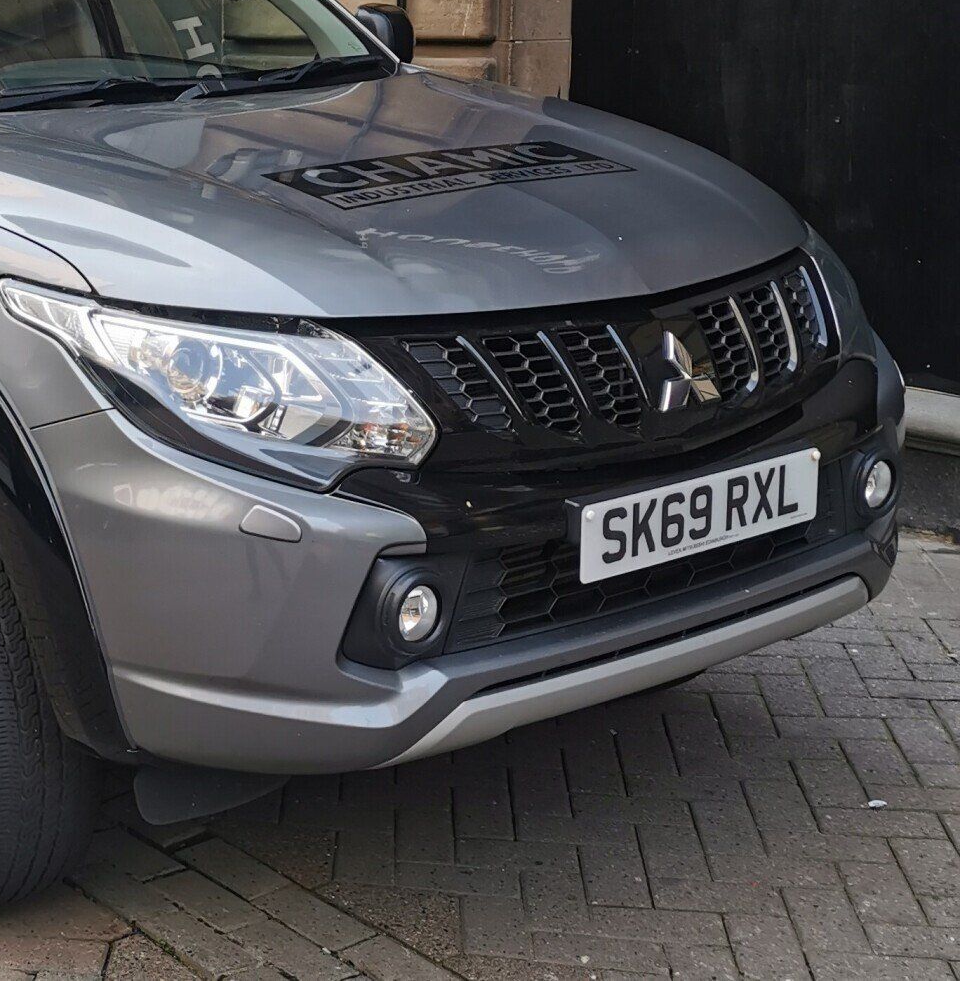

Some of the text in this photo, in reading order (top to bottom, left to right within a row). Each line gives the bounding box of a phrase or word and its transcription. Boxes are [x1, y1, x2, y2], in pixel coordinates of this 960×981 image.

[301, 140, 578, 190] CHAMIC
[336, 161, 616, 206] INDUSTRIAL SERVICES LTD
[601, 464, 799, 564] SK69 RXL
